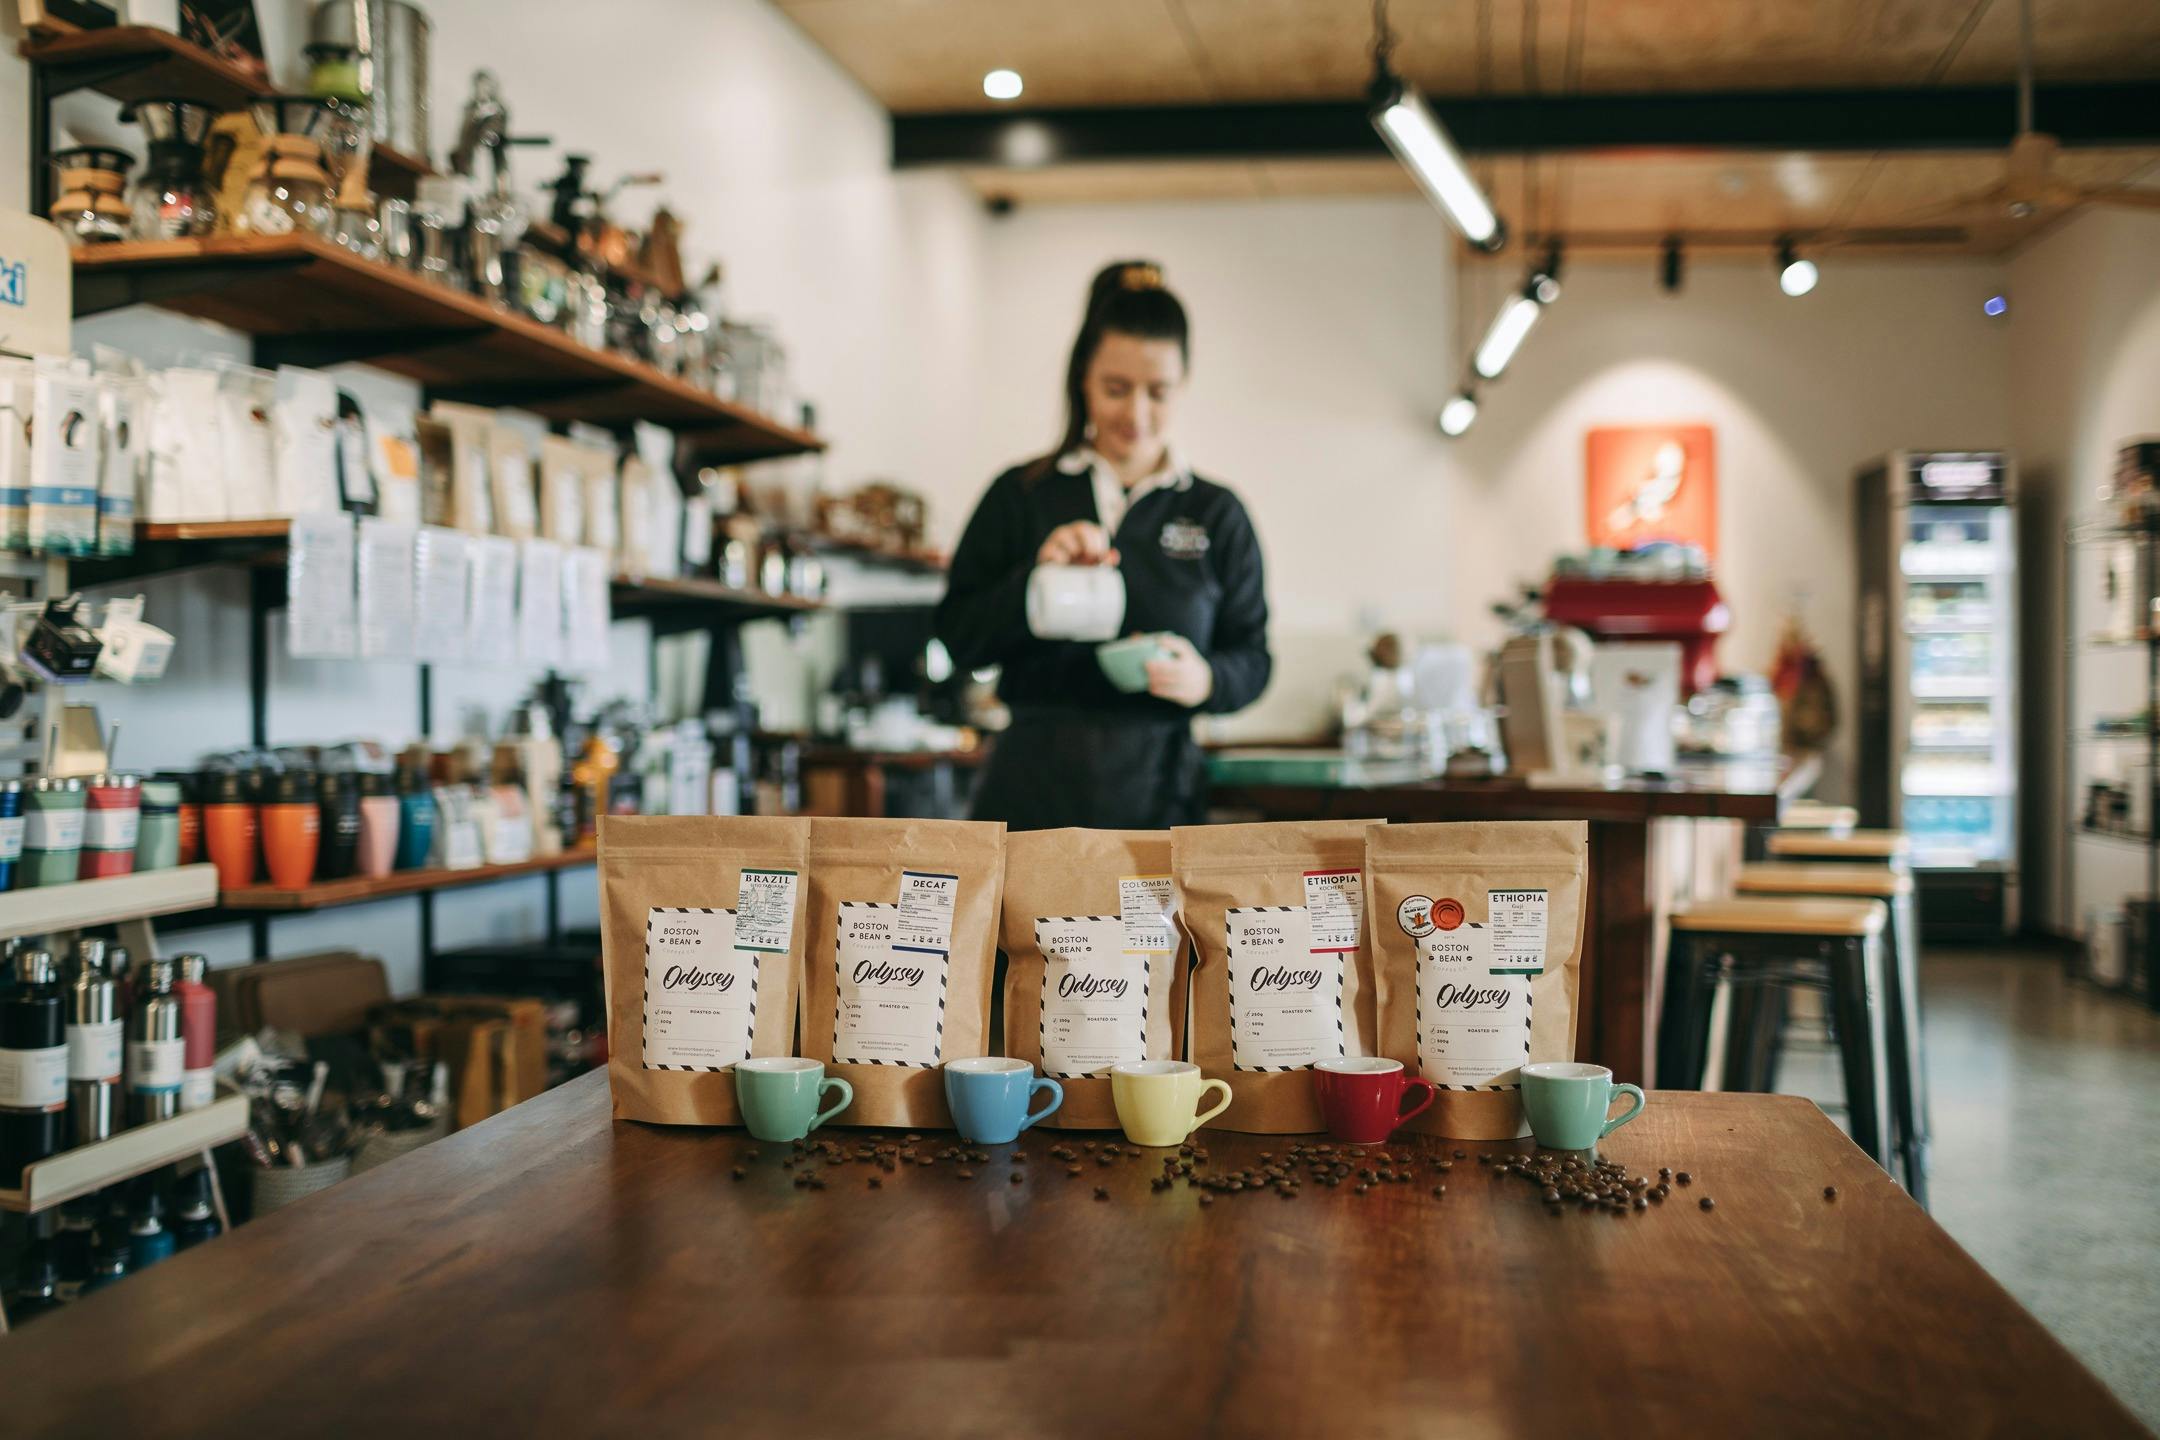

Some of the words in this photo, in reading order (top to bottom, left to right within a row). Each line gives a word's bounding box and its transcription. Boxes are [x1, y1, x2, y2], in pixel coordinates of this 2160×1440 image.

[745, 874, 790, 884] BRAZIL
[1307, 875, 1357, 886] ETHIOPIA
[913, 880, 947, 888] DECAF
[1121, 880, 1171, 888] COLOMBIA
[1493, 894, 1544, 902] ETHIOPIA
[853, 922, 888, 930] BOSTON
[663, 927, 699, 935] BOSTON
[1243, 927, 1280, 936] BOSTON
[859, 932, 881, 940] BEAN
[1052, 936, 1088, 944] BOSTON
[669, 937, 691, 945] BEAN
[1059, 946, 1081, 954] BEAN
[1439, 954, 1462, 962] BEAN
[852, 959, 924, 986] Odyssey
[662, 964, 735, 992] Odyssey
[1250, 965, 1322, 991] Odyssey
[1058, 973, 1128, 998] Odyssey
[1436, 983, 1510, 1009] Odyssey
